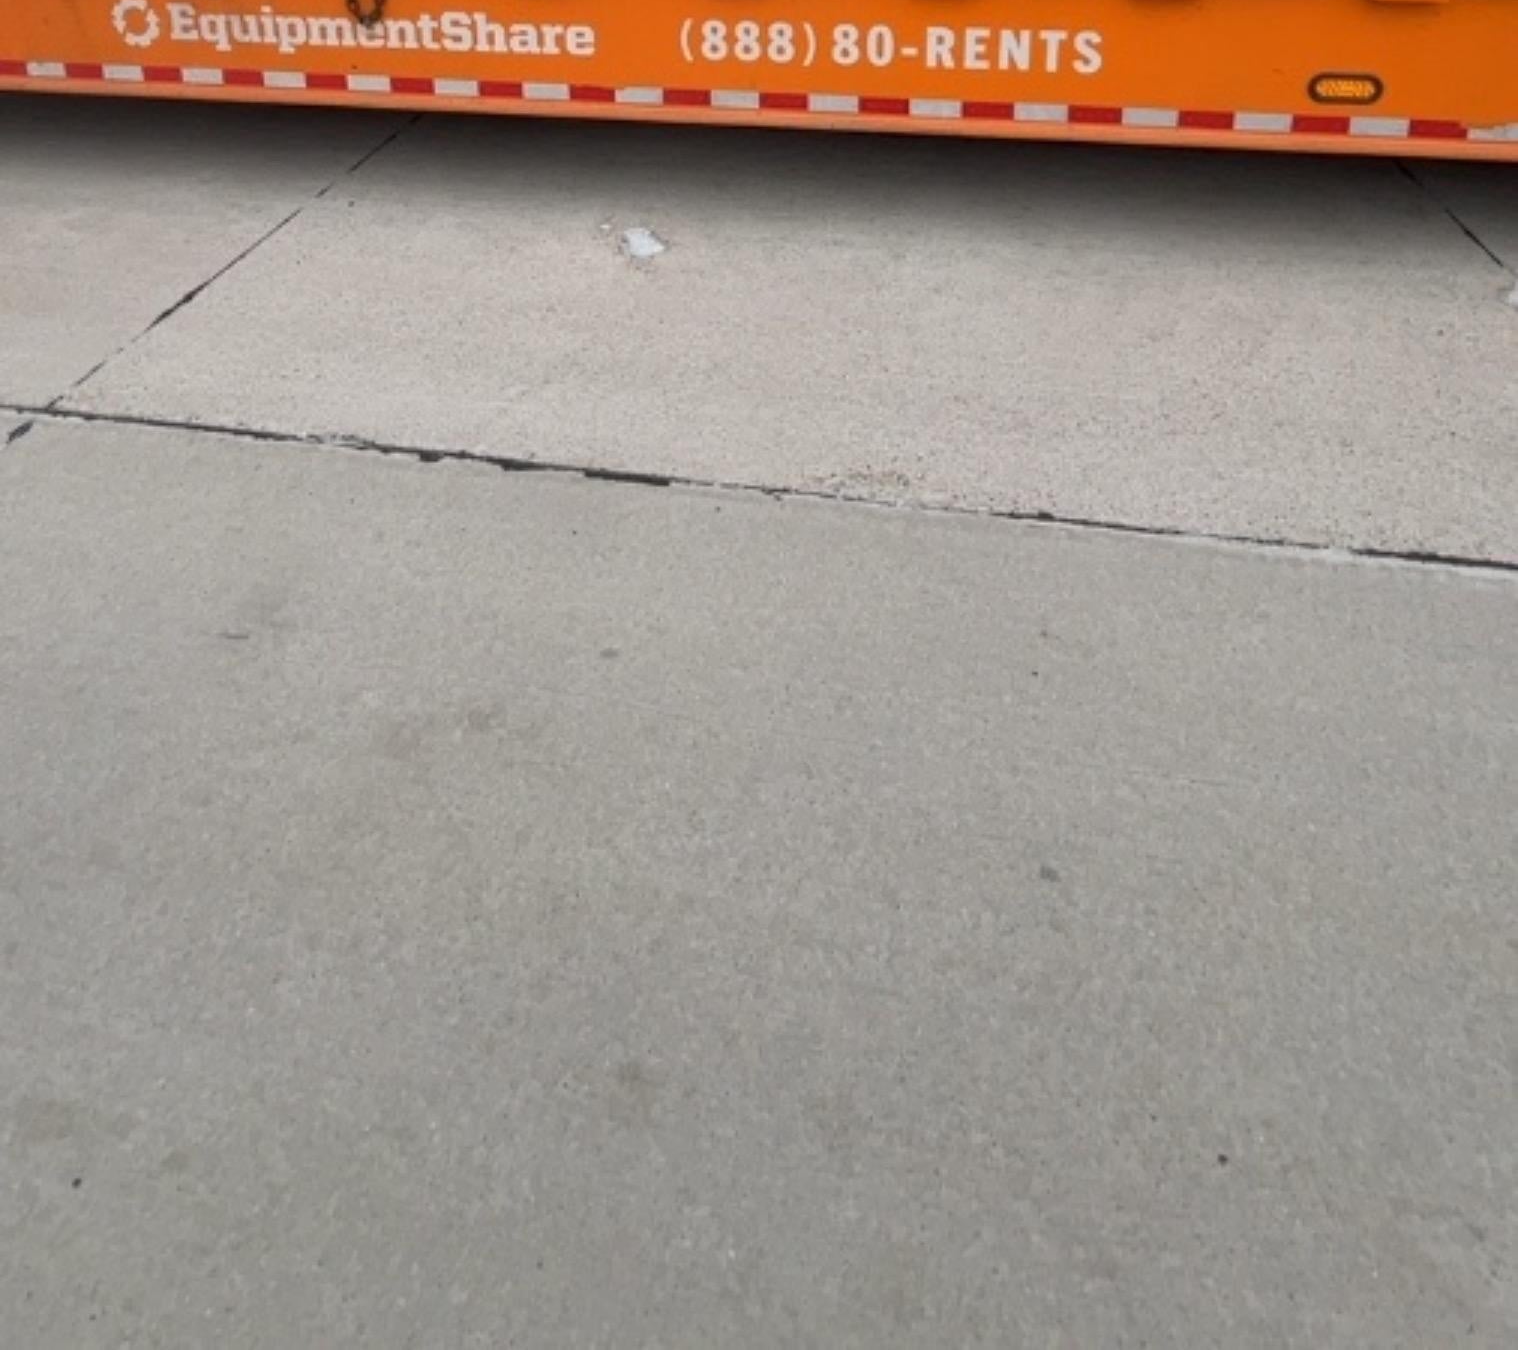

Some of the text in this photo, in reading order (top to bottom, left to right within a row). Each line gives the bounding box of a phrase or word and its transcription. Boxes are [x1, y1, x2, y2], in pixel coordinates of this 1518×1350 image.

[167, 3, 596, 55] EquipmentShare
[679, 19, 1104, 74] (888) 80-RENTS
